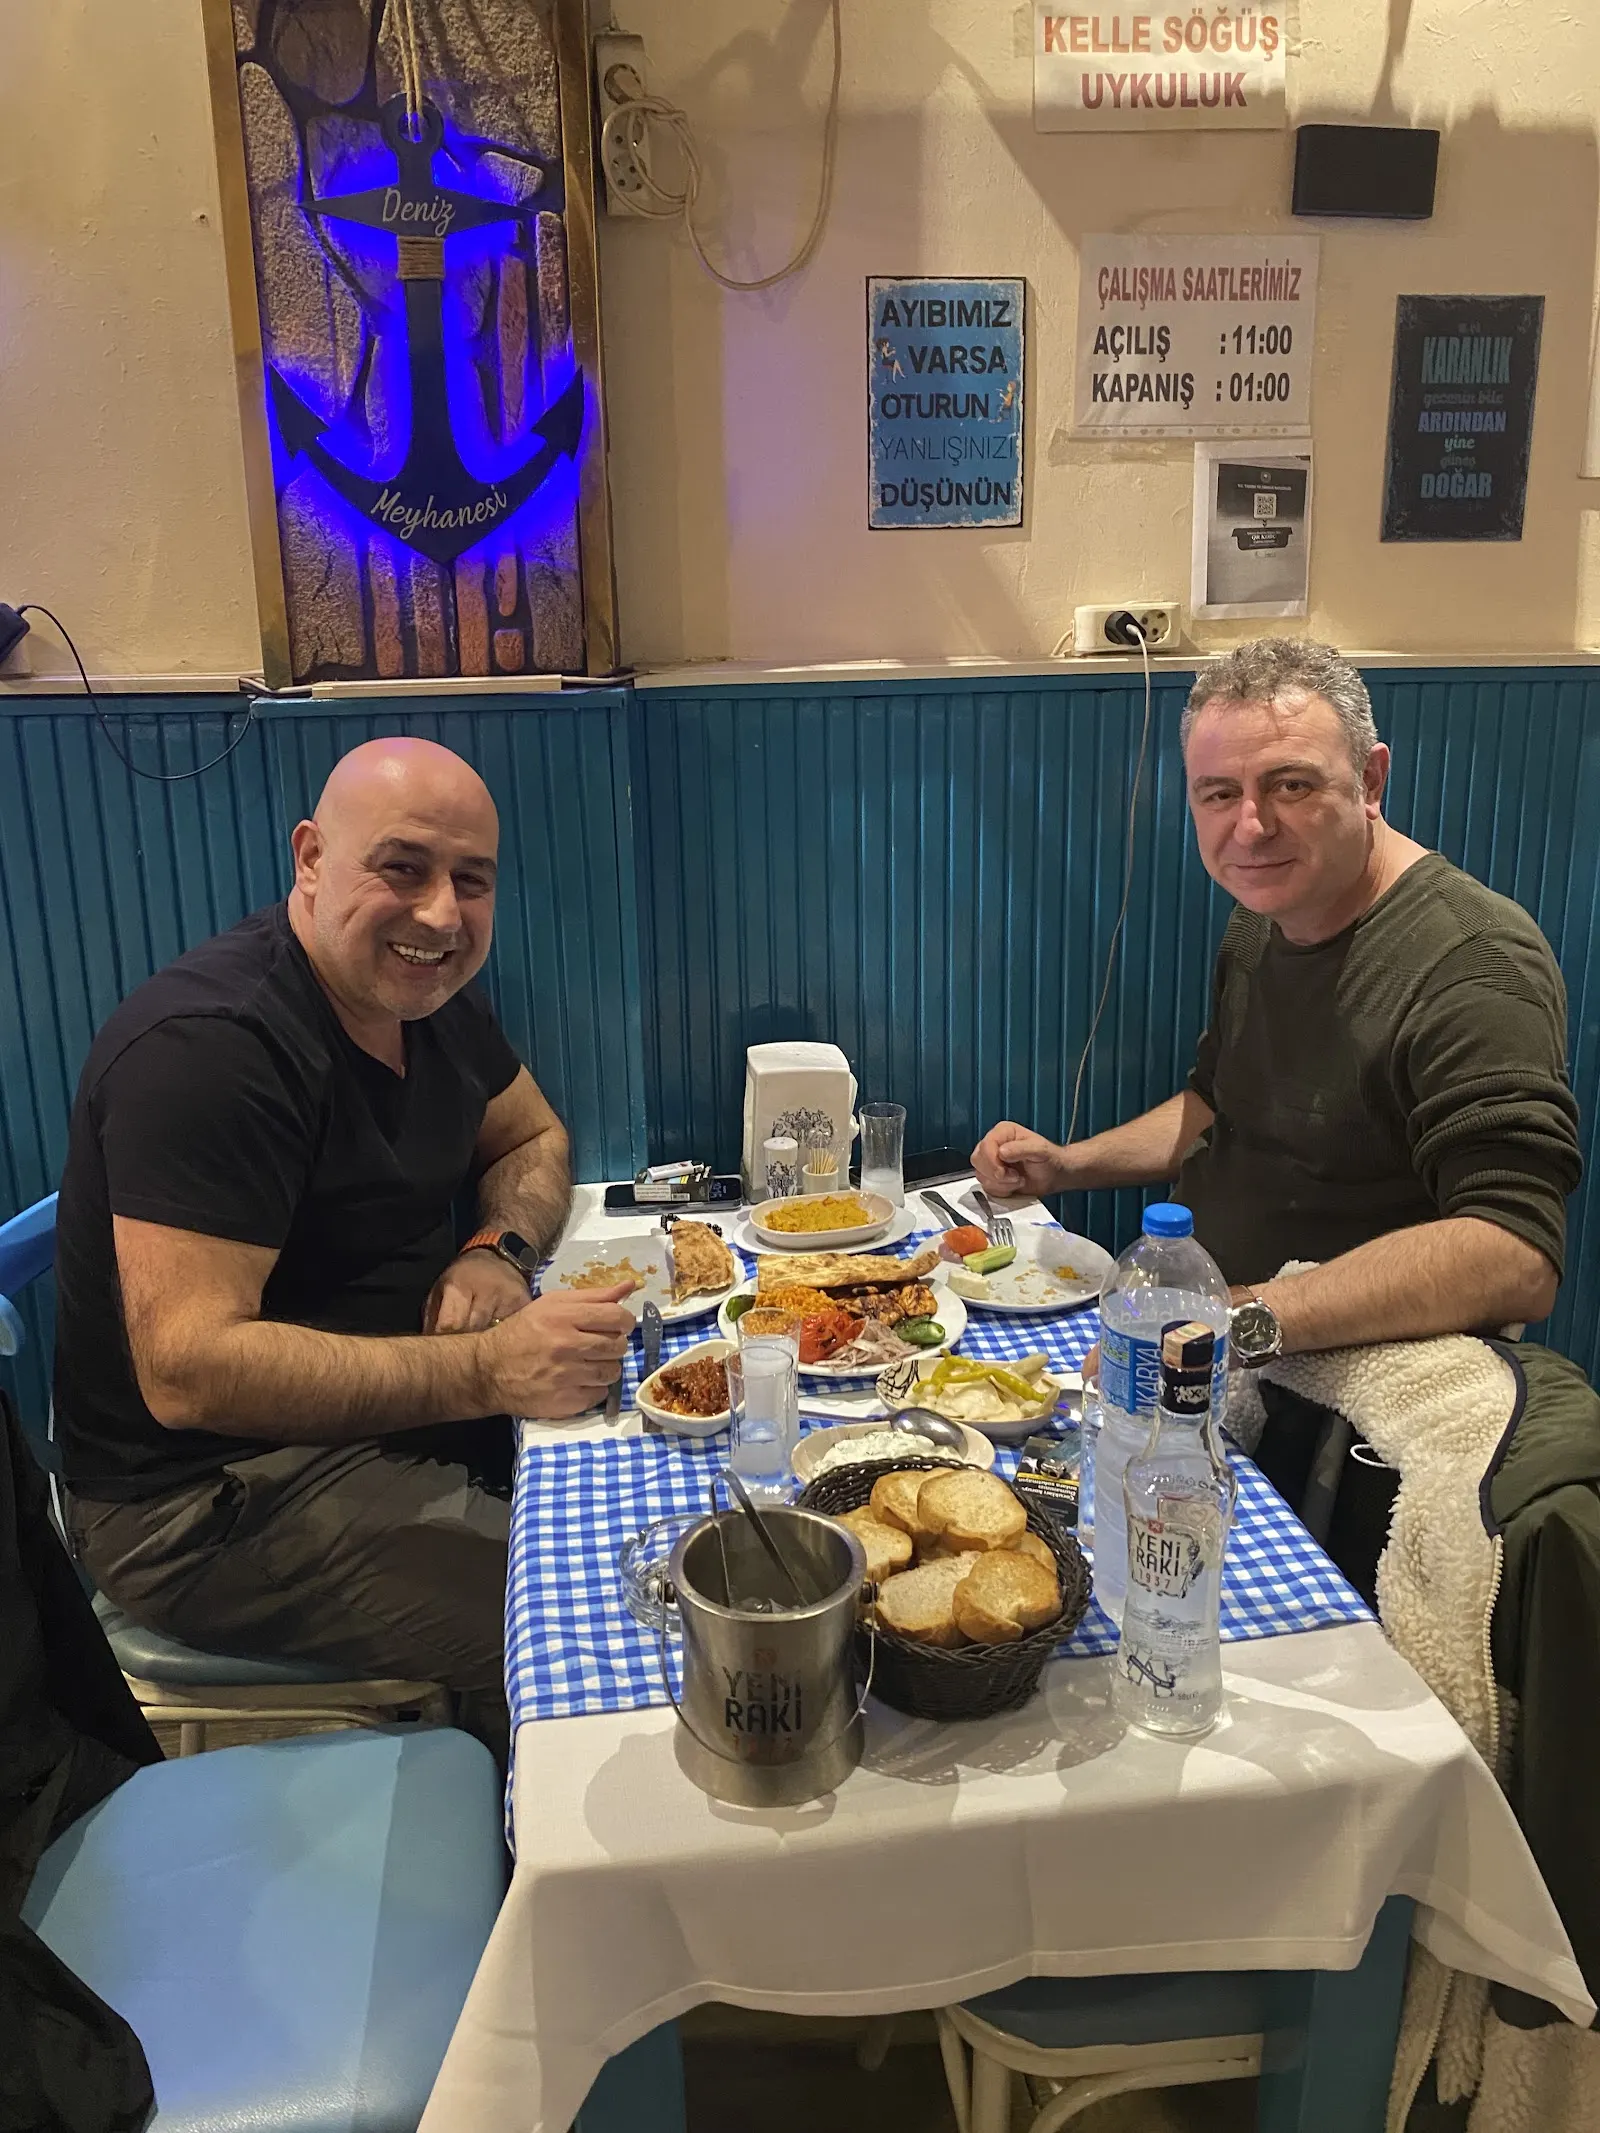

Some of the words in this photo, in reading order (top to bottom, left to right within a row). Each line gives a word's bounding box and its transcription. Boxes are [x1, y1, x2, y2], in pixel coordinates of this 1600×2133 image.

[1044, 16, 1150, 53] KELLE
[1162, 8, 1279, 61] SÖĞÜŞ
[1082, 72, 1247, 109] UYKULUK
[382, 188, 455, 236] Deniz
[1098, 267, 1177, 310] ÇALIŞMA
[1182, 258, 1301, 301] SAATLERİMİZ
[880, 299, 1012, 328] AYIBIMIZ
[908, 345, 1008, 374] VARSA
[1093, 326, 1171, 362] AÇILIŞ
[1421, 336, 1513, 384] KARANLIK
[881, 394, 989, 420] OTURUN
[1092, 373, 1195, 410] KAPANIŞ
[1418, 411, 1507, 432] ARDINDAN
[1444, 434, 1476, 452] yine
[880, 480, 1012, 511] DÜŞÜNÜN
[1420, 469, 1492, 498] DOĞAR
[370, 486, 508, 538] Meyhanesi
[1136, 1546, 1180, 1577] RAKI
[1138, 1568, 1171, 1590] 1937
[725, 1697, 802, 1732] RAKI
